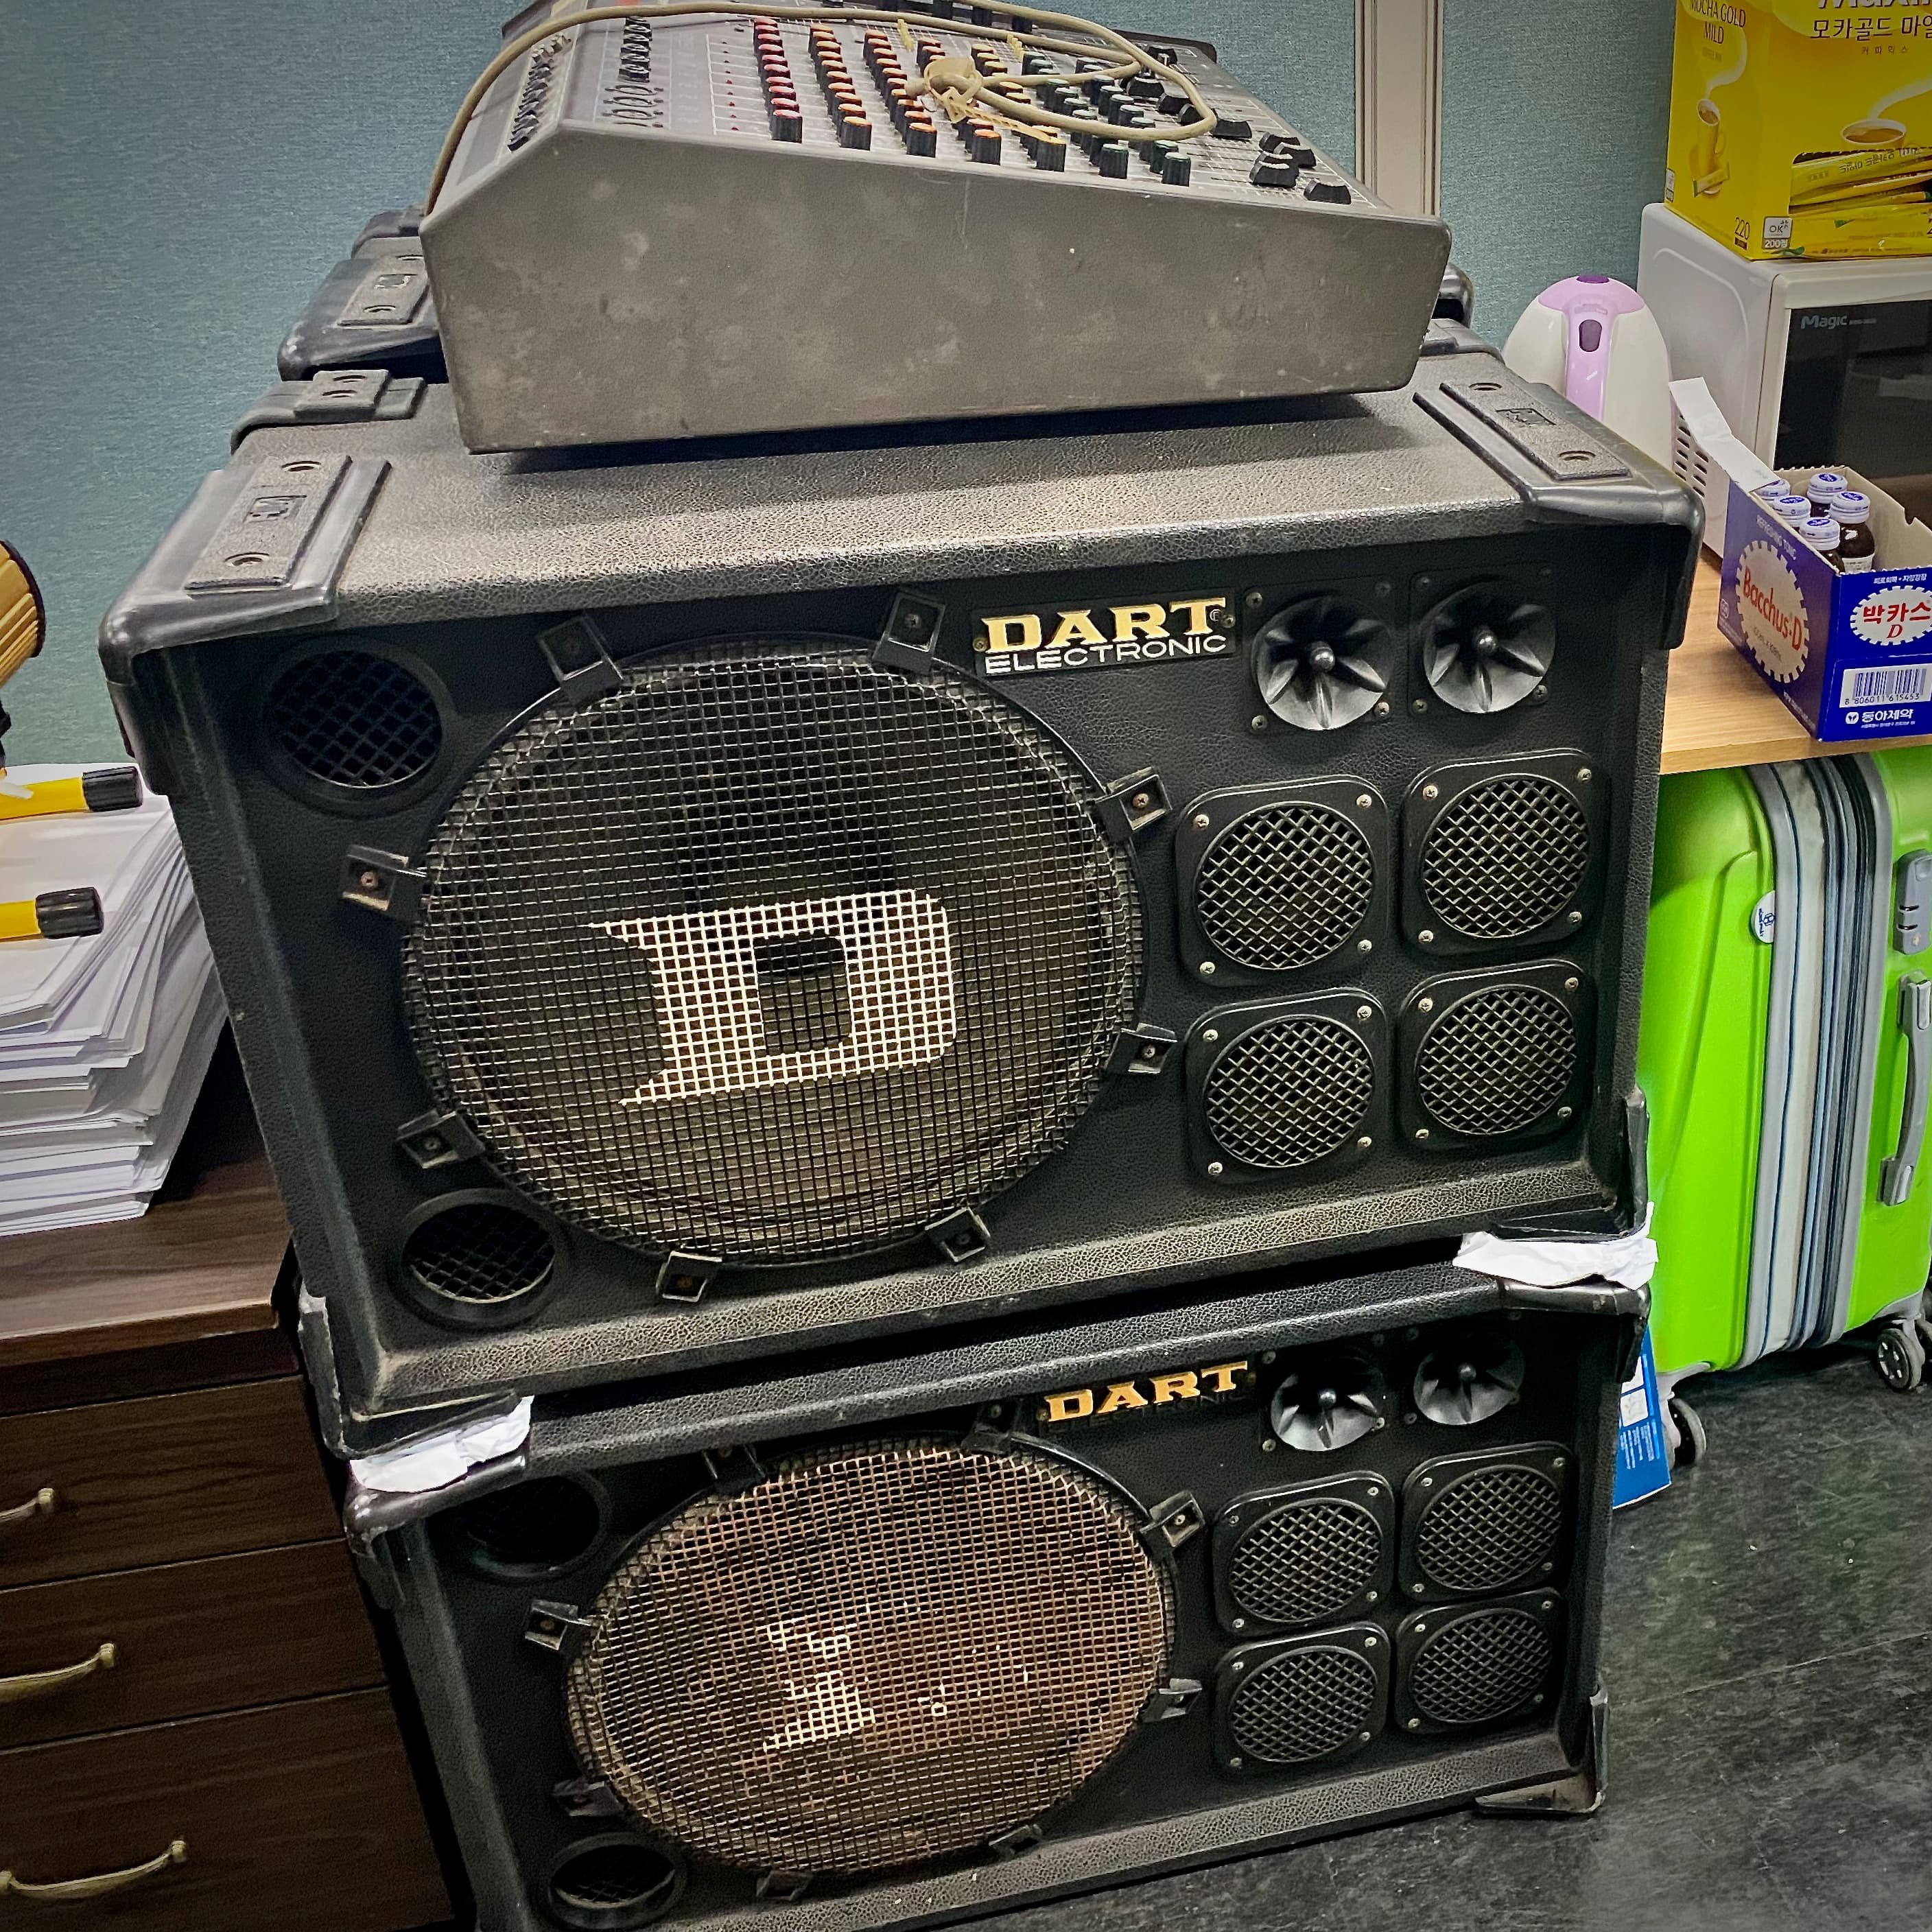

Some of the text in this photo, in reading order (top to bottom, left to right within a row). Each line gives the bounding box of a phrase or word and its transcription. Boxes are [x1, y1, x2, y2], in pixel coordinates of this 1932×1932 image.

[1720, 3, 1746, 27] GOLD
[1704, 21, 1724, 44] MILD
[1810, 17, 1893, 41] 모카골드
[1734, 217, 1750, 240] 220
[1769, 224, 1784, 233] OK
[1801, 315, 1848, 330] Magic
[1863, 602, 1931, 624] 박카스
[980, 597, 1226, 653] DART
[1886, 624, 1902, 638] D
[985, 635, 1227, 674] ELECTRONIC
[1861, 709, 1914, 722] 동아제약
[1043, 1360, 1249, 1422] DART
